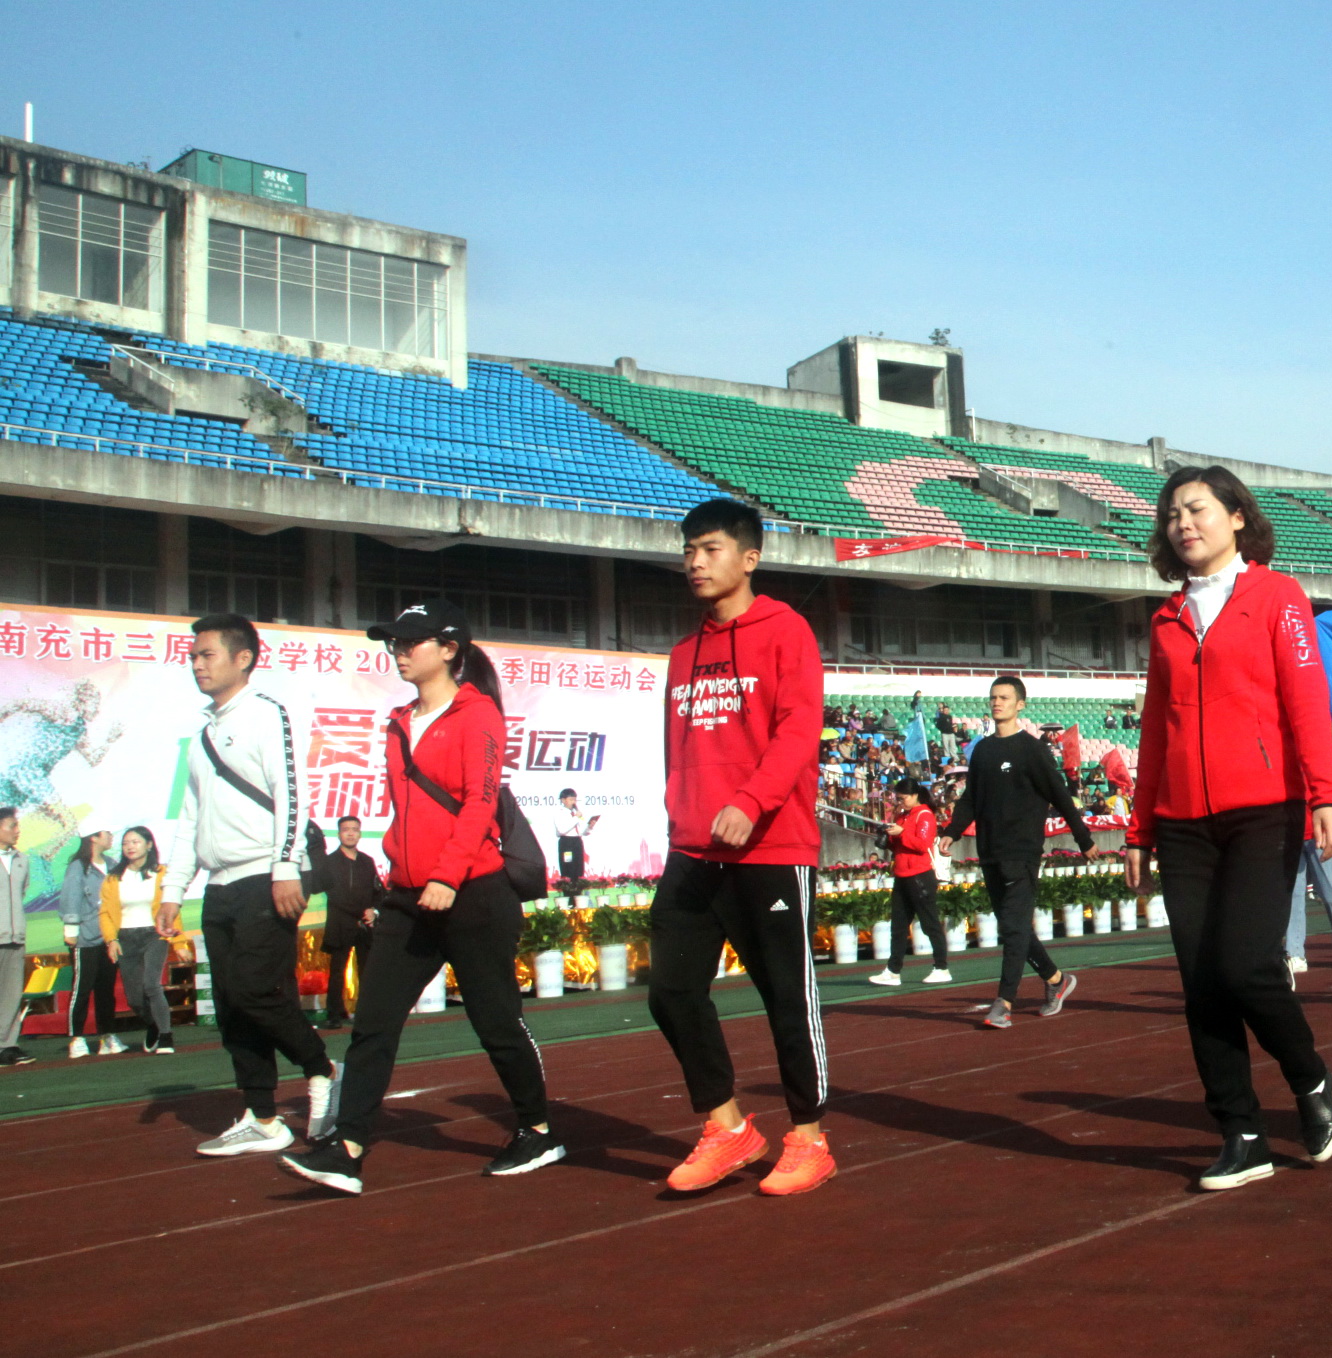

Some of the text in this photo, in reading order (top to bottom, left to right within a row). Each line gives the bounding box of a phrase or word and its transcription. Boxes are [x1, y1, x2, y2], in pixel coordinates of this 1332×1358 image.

[672, 677, 758, 702] HEAVYWEIGHT
[677, 696, 742, 717] CHAMPION
[690, 718, 704, 726] EEP
[516, 795, 635, 807] 2019.10.1 2019.10.19
